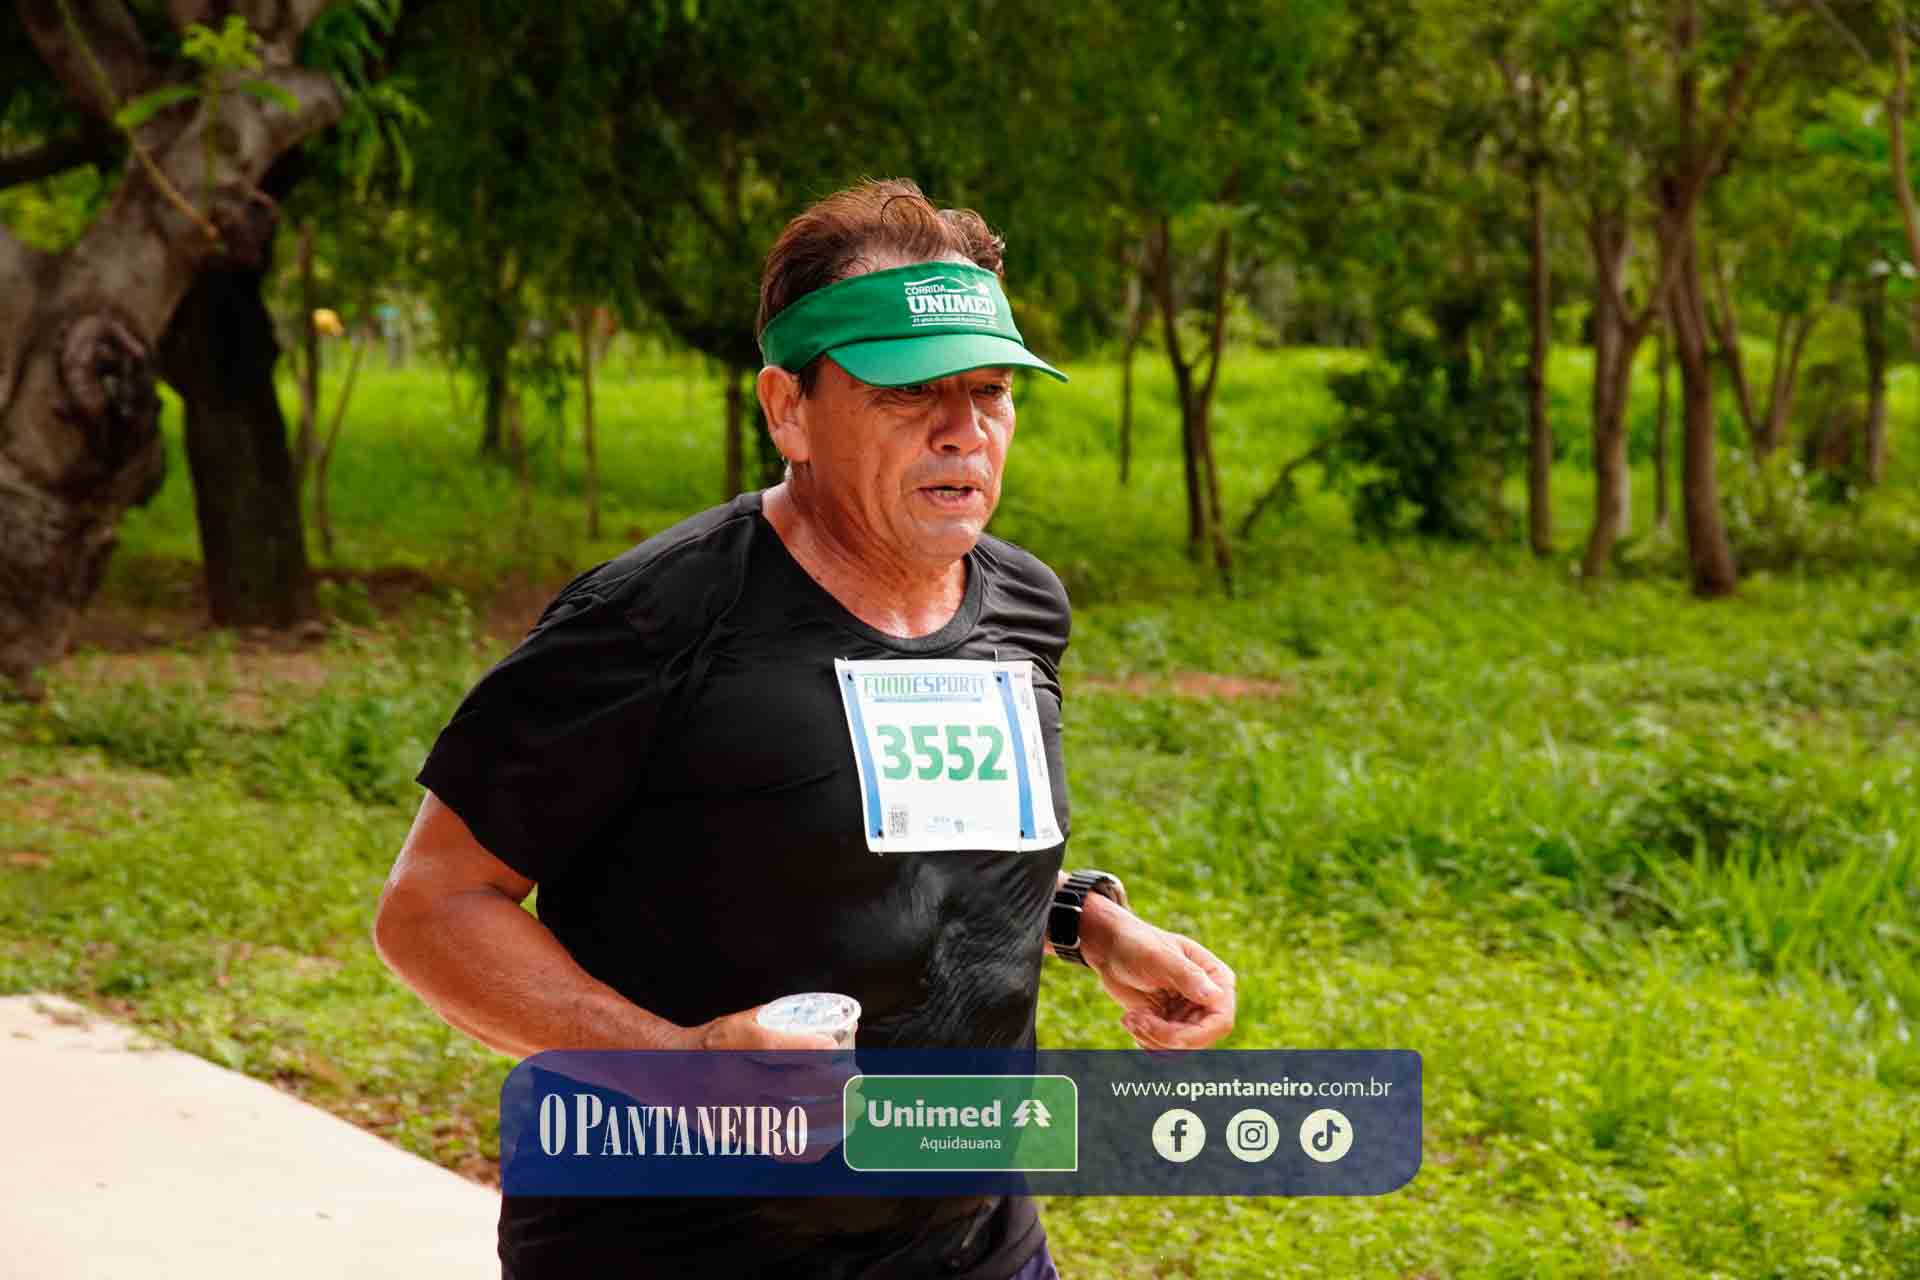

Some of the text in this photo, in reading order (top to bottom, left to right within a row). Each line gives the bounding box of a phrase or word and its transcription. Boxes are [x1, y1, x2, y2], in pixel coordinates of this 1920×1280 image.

[905, 284, 945, 295] CORRIDA
[907, 294, 997, 315] UNIMED
[876, 725, 1008, 780] 3552
